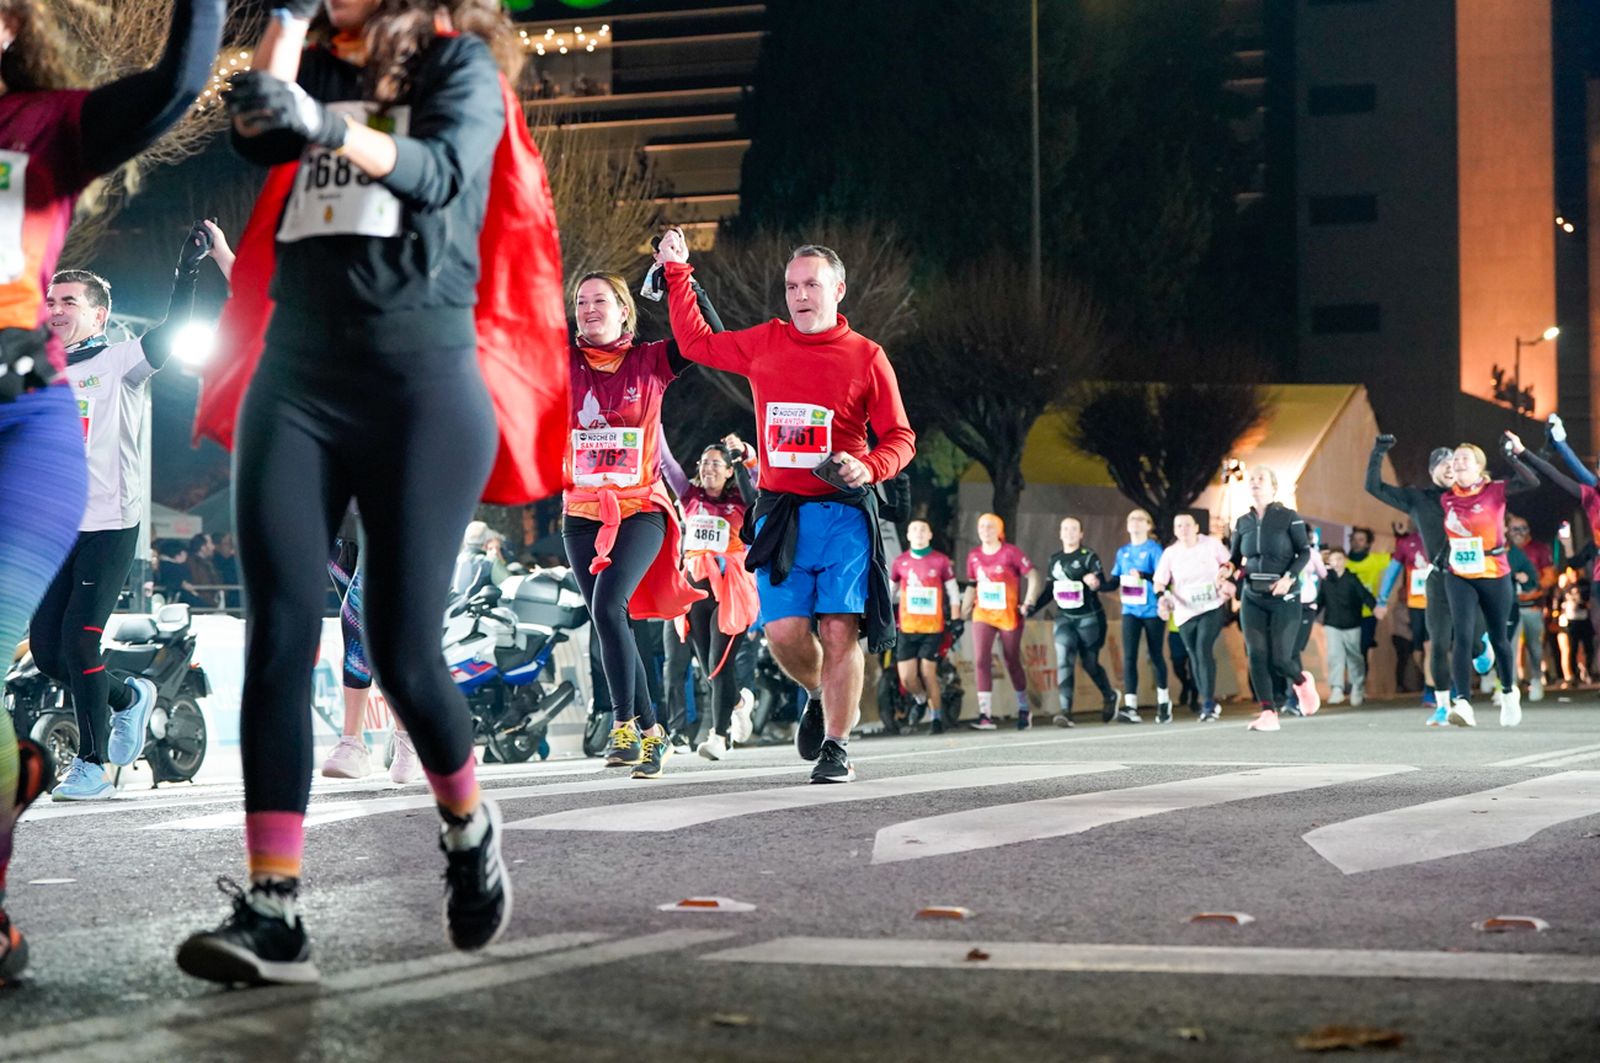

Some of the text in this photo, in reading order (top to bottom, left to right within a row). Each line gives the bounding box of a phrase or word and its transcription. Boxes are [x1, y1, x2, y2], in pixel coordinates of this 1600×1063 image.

[588, 433, 617, 441] NOCHE DE
[587, 449, 627, 468] 9762
[694, 529, 721, 542] 4861
